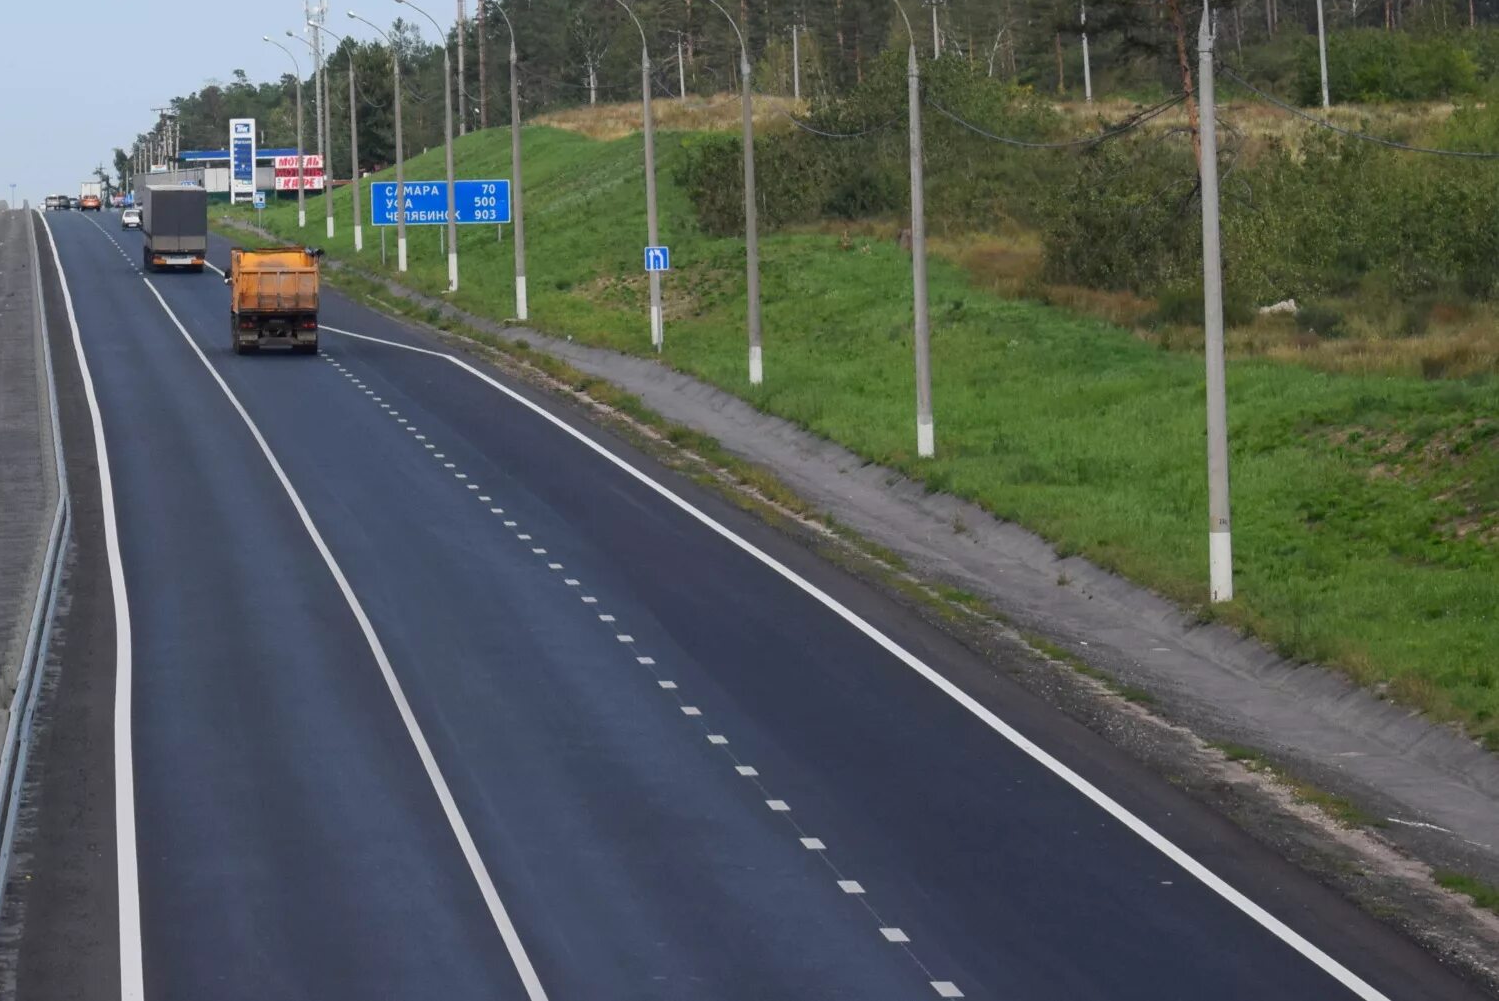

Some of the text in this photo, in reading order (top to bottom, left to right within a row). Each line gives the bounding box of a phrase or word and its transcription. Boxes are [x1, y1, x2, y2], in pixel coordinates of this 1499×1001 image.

[279, 157, 320, 167] МОТЛЬ
[481, 184, 496, 194] 70
[474, 197, 496, 207] 500
[474, 210, 497, 220] 903
